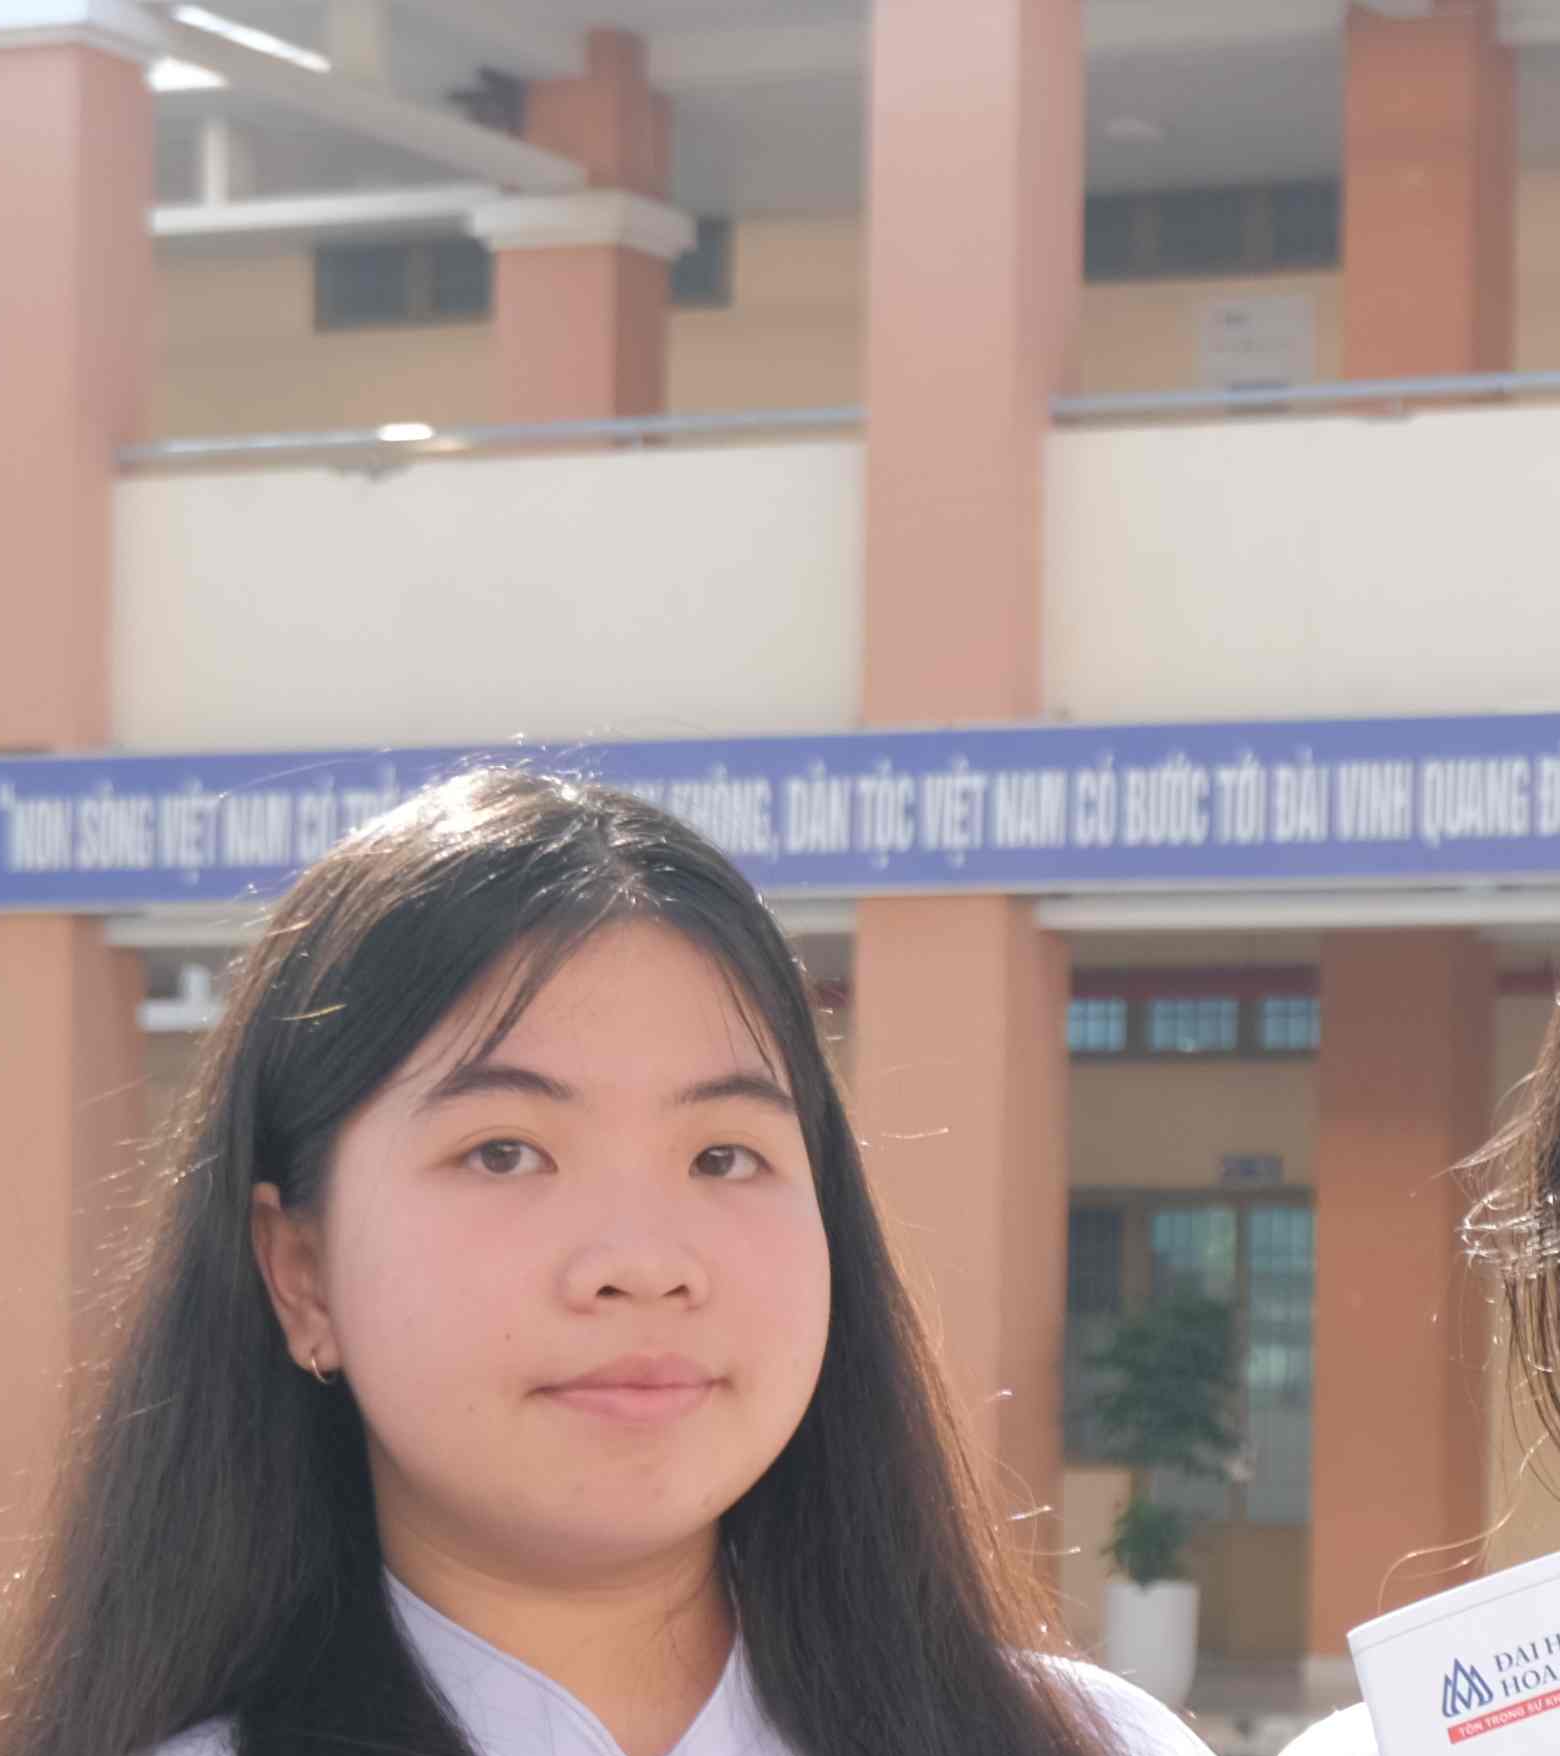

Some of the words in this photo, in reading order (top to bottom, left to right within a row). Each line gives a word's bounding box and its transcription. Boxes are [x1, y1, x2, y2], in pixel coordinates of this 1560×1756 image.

[77, 780, 153, 870] SÔNG
[157, 778, 220, 886] VIỆT
[223, 790, 291, 868] NAM
[785, 756, 851, 855] DÂN
[856, 755, 915, 870] TỘC
[920, 753, 988, 870] VIỆT
[994, 767, 1067, 849] NAM
[1072, 750, 1117, 848] CÓ
[1124, 750, 1210, 847] BƯỚC
[1215, 750, 1267, 846] TỚI
[1336, 758, 1413, 842] VINH
[1421, 754, 1531, 848] QUANG
[1500, 1664, 1558, 1698] HOA
[1459, 1722, 1483, 1738] TÔN
